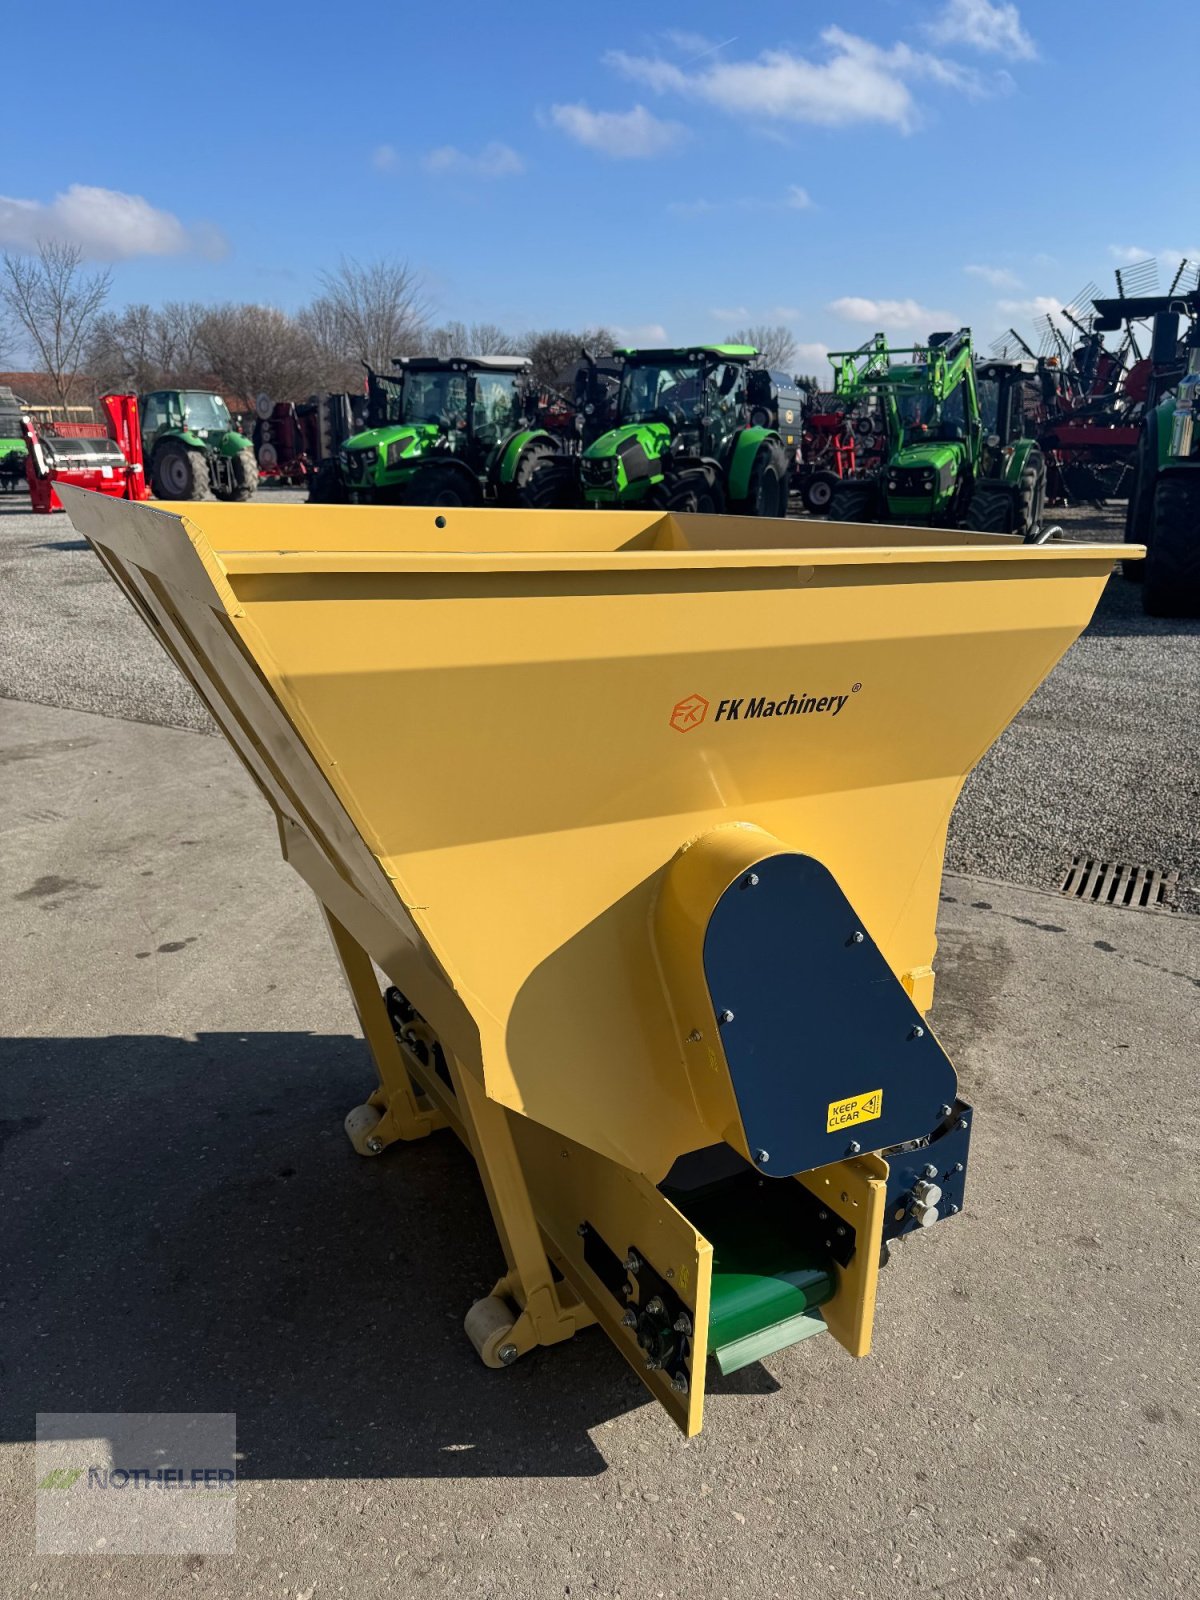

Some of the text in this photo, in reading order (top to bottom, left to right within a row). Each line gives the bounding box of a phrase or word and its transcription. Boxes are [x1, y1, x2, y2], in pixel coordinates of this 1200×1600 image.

[715, 698, 745, 722] FK
[744, 693, 849, 720] Machinery
[833, 1102, 857, 1115] KEEP
[829, 1111, 859, 1126] CLEAR
